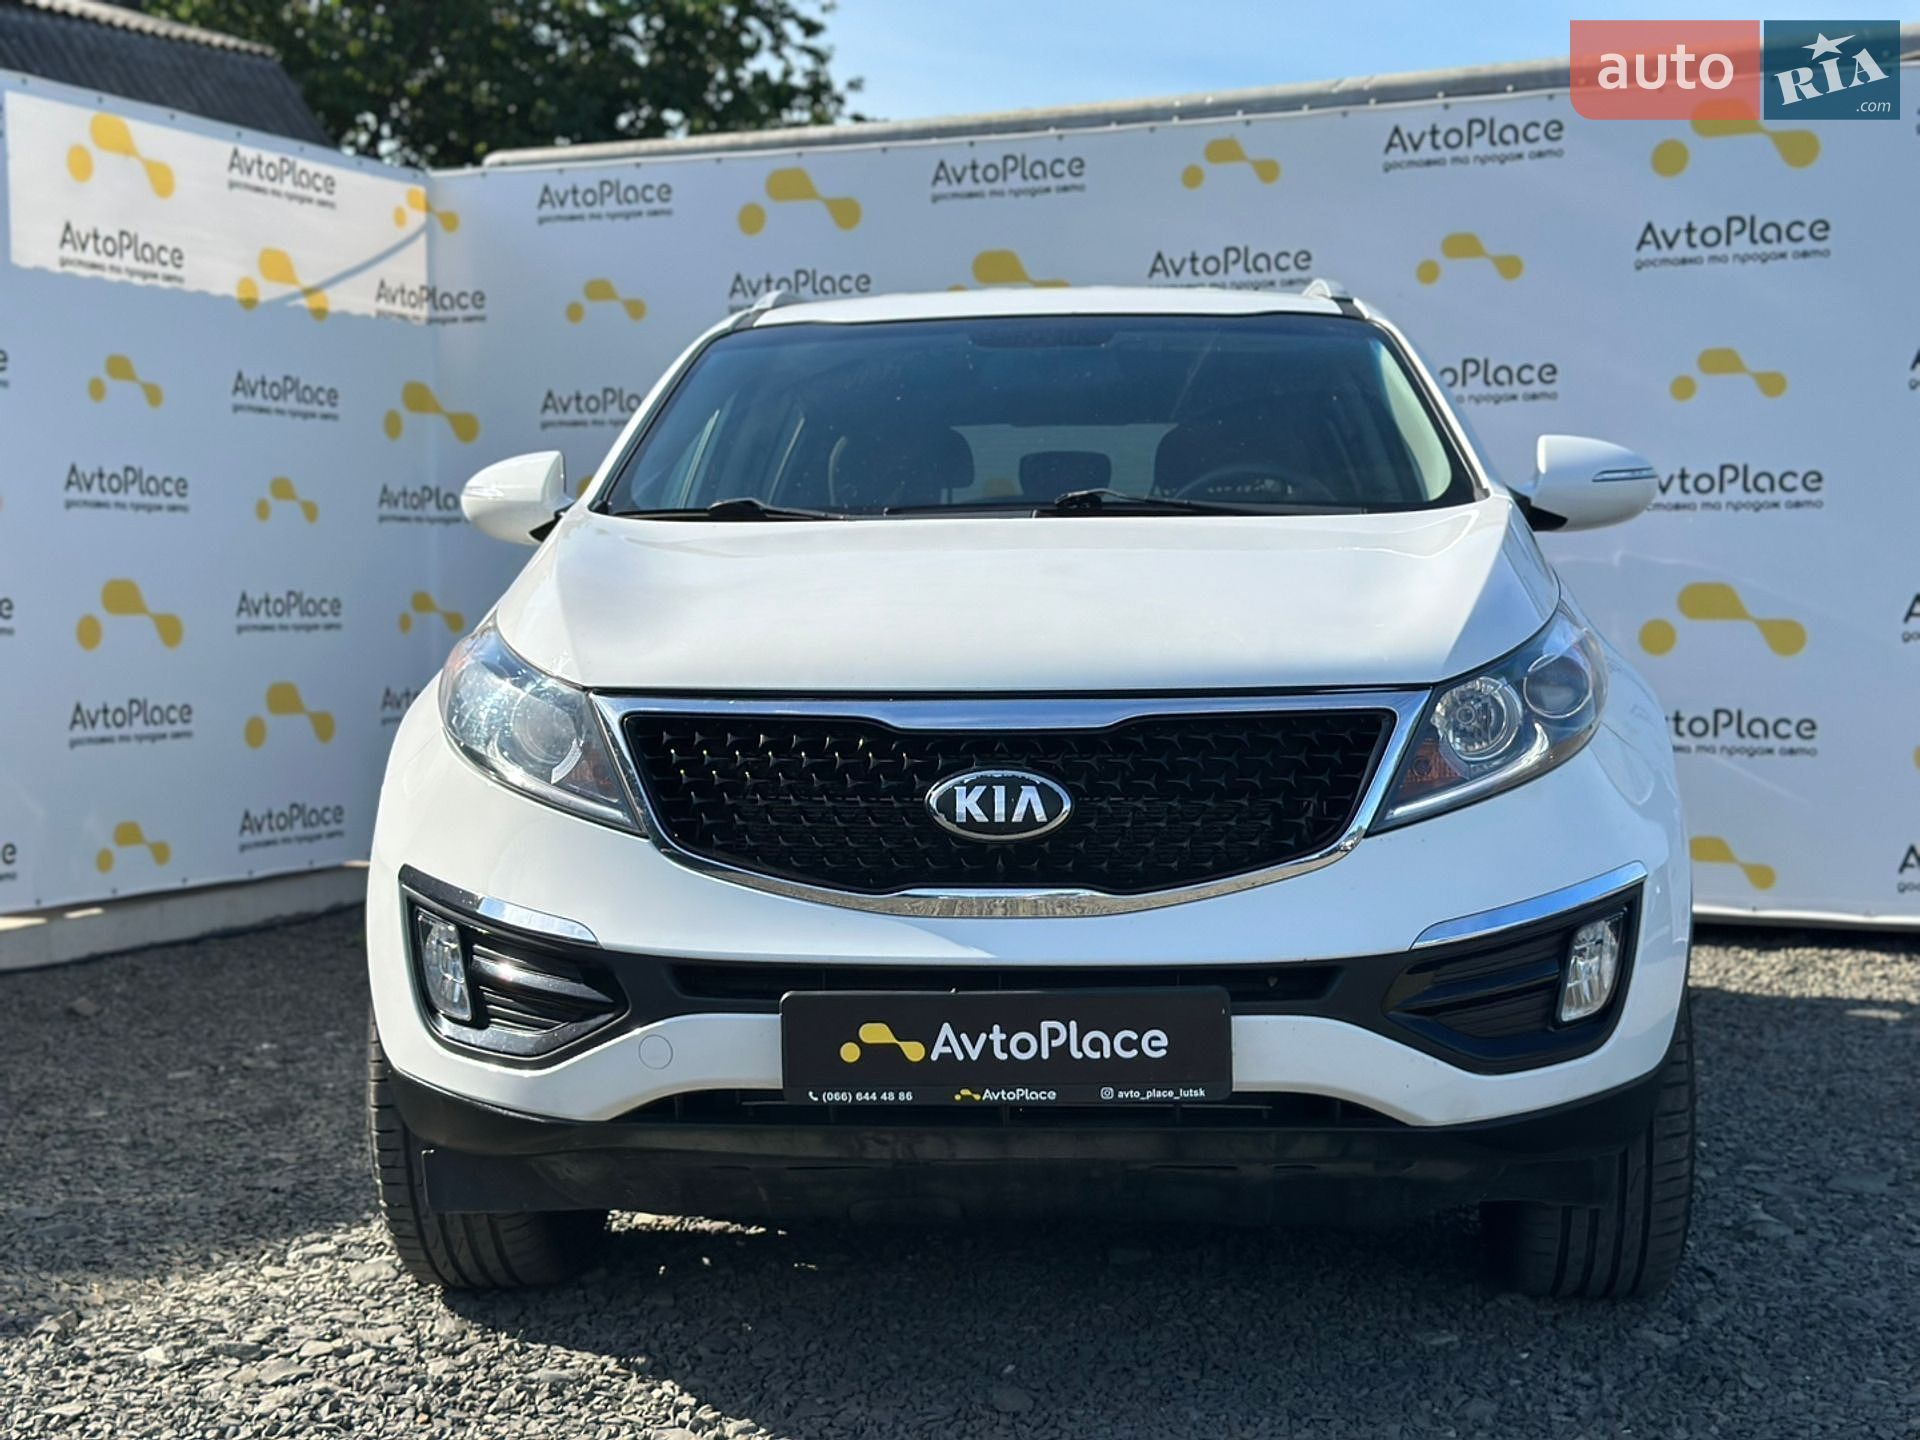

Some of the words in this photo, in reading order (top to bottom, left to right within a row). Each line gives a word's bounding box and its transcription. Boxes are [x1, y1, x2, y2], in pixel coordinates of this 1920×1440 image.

[1384, 117, 1564, 154] AvtoPlace
[228, 147, 336, 196] AvtoPlace
[931, 154, 1086, 186] AvtoPlace
[538, 180, 672, 209] AvtoPlace
[60, 220, 184, 269] AvtoPlace
[1636, 216, 1830, 251] AvtoPlace
[1148, 246, 1312, 278] AvtoPlace
[375, 278, 486, 312] AvtoPlace
[729, 268, 871, 298] AvtoPlace
[1439, 358, 1557, 387] oPlace
[232, 370, 339, 408] AvtoPlace
[541, 387, 641, 414] AvtoPla
[64, 463, 188, 498] AvtoPlace
[1658, 464, 1824, 494] vtoPlace
[379, 484, 460, 511] AvtoPla
[236, 590, 342, 618] AvtoPlace
[70, 697, 192, 730] AvtoPlace
[1668, 708, 1817, 740] toPlace
[240, 802, 344, 836] AvtoPlace
[954, 785, 1048, 823] KIA
[930, 1020, 1169, 1060] AvtoPlace
[822, 1091, 852, 1103] (066)
[855, 1091, 877, 1101] 644
[880, 1091, 895, 1101] 48
[898, 1091, 913, 1101] 86
[982, 1088, 1057, 1101] AvtoPlace
[1117, 1088, 1206, 1100] avto_place_lutsk
